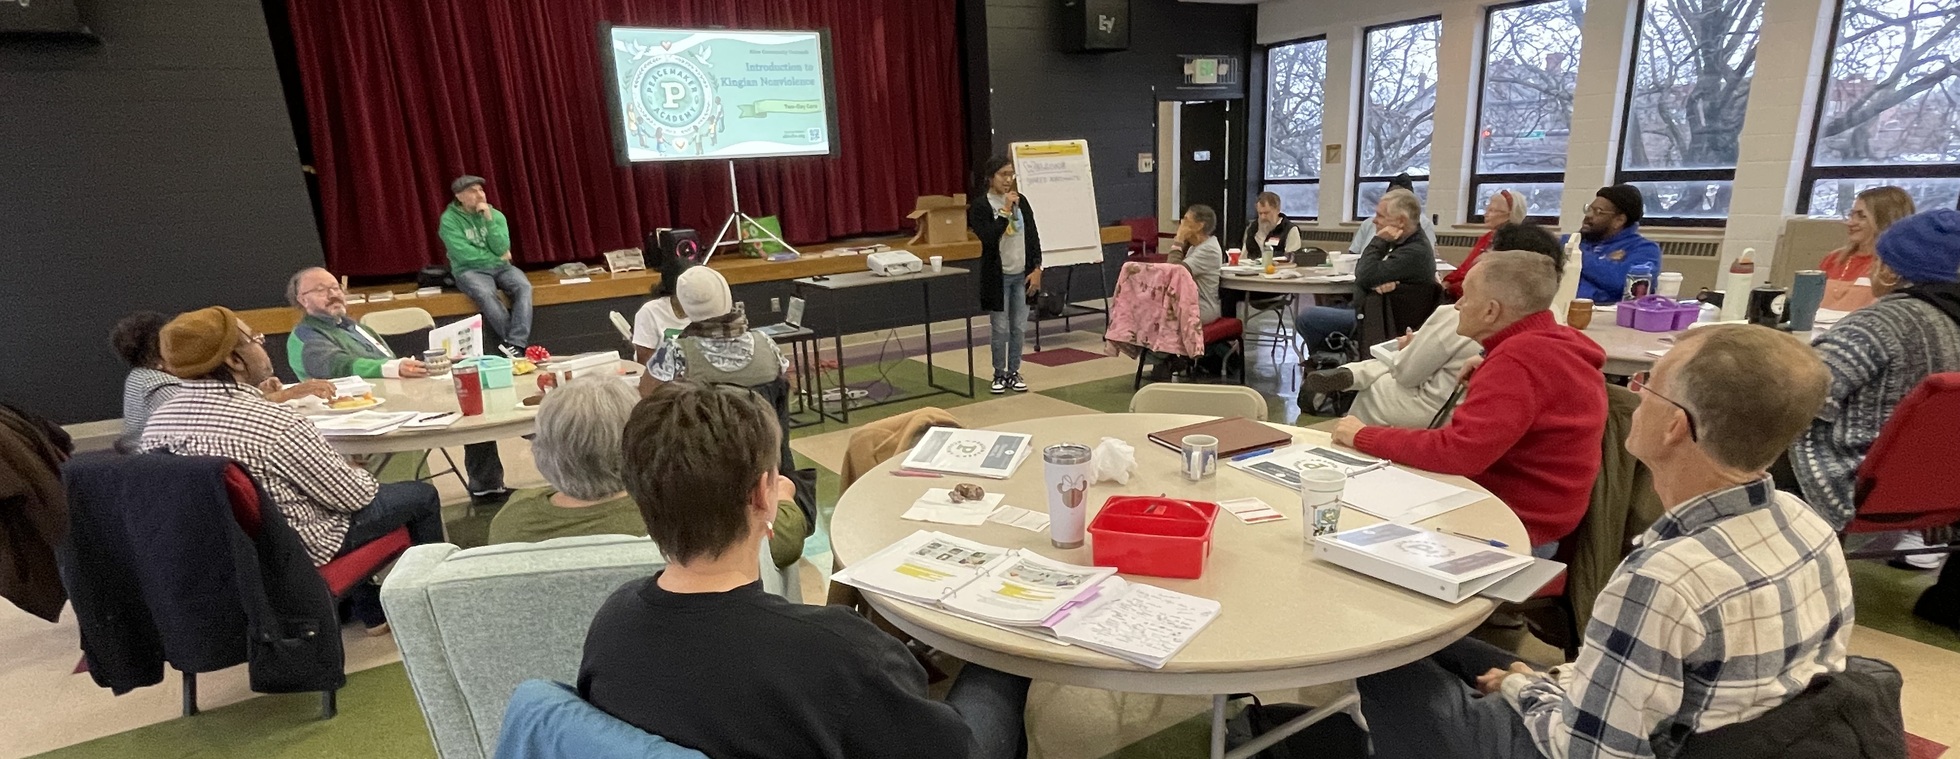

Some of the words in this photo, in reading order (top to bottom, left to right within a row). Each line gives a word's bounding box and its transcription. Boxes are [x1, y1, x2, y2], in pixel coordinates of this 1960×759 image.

[746, 62, 802, 71] Introduction
[647, 69, 697, 93] PEACEMAKER
[720, 77, 758, 89] Kingian
[760, 76, 815, 86] Nonviolence
[661, 82, 685, 108] P
[654, 107, 696, 122] ACADEMY
